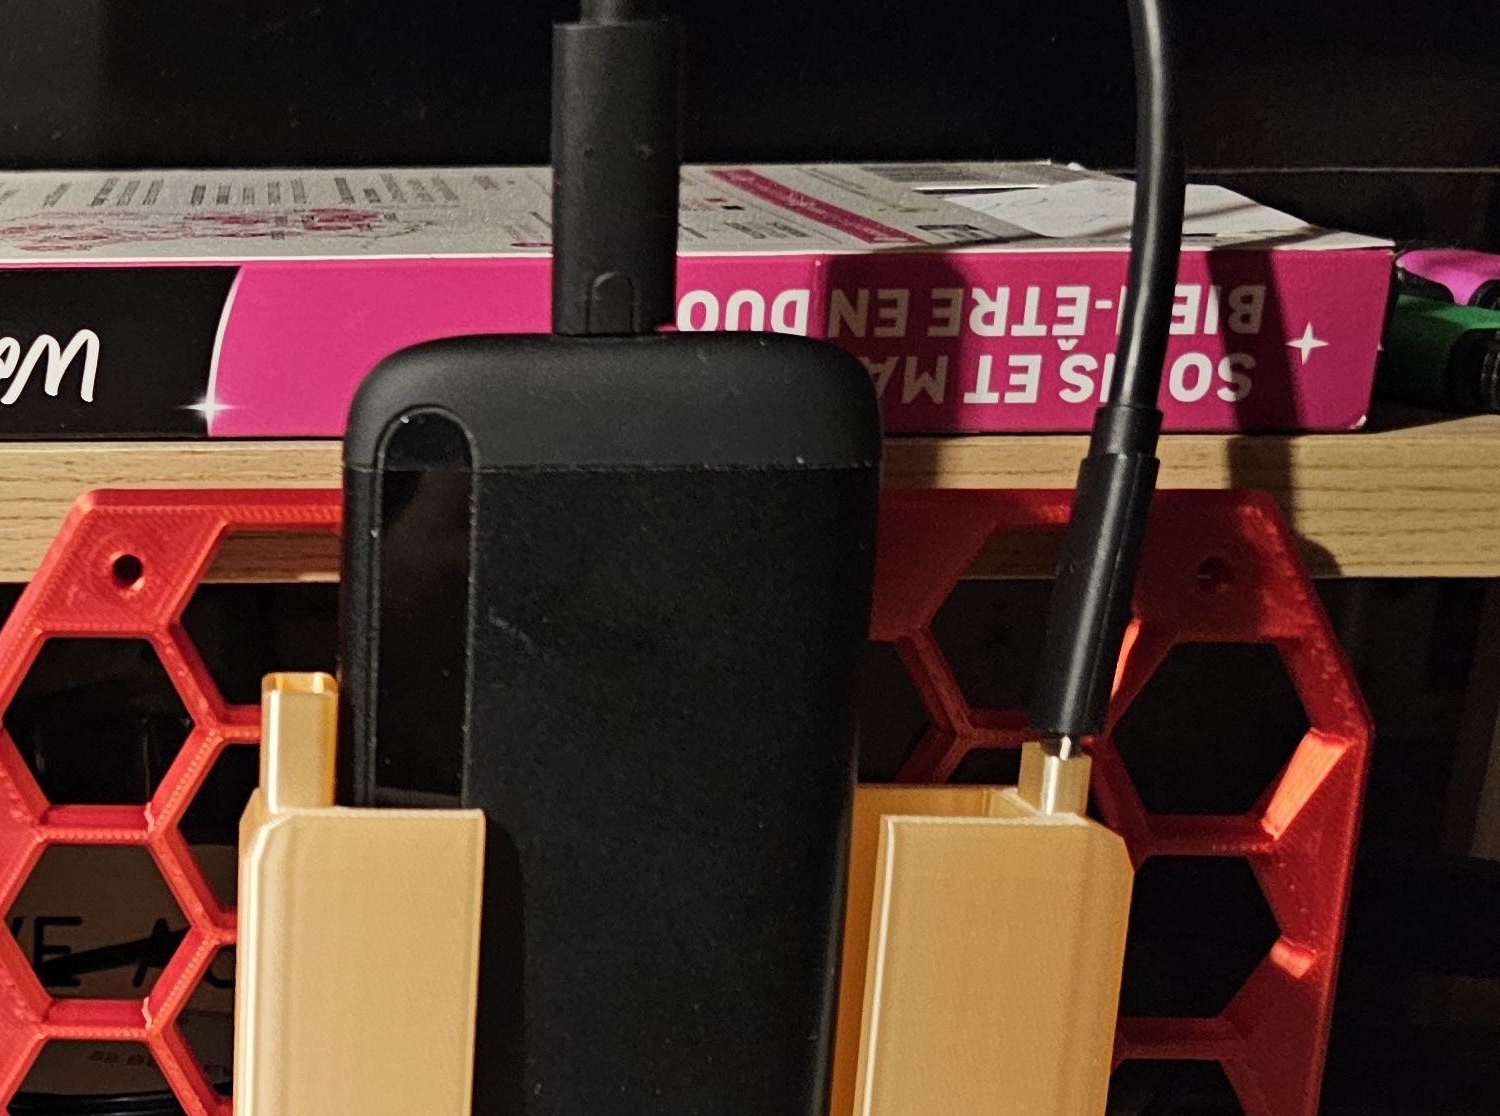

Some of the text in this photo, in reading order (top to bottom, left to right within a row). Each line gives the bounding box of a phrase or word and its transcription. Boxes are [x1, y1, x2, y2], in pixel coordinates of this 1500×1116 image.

[677, 284, 1267, 351] BIE-ÊTRE EN DUO
[963, 354, 1043, 404] ET
[1058, 353, 1257, 404] SOS
